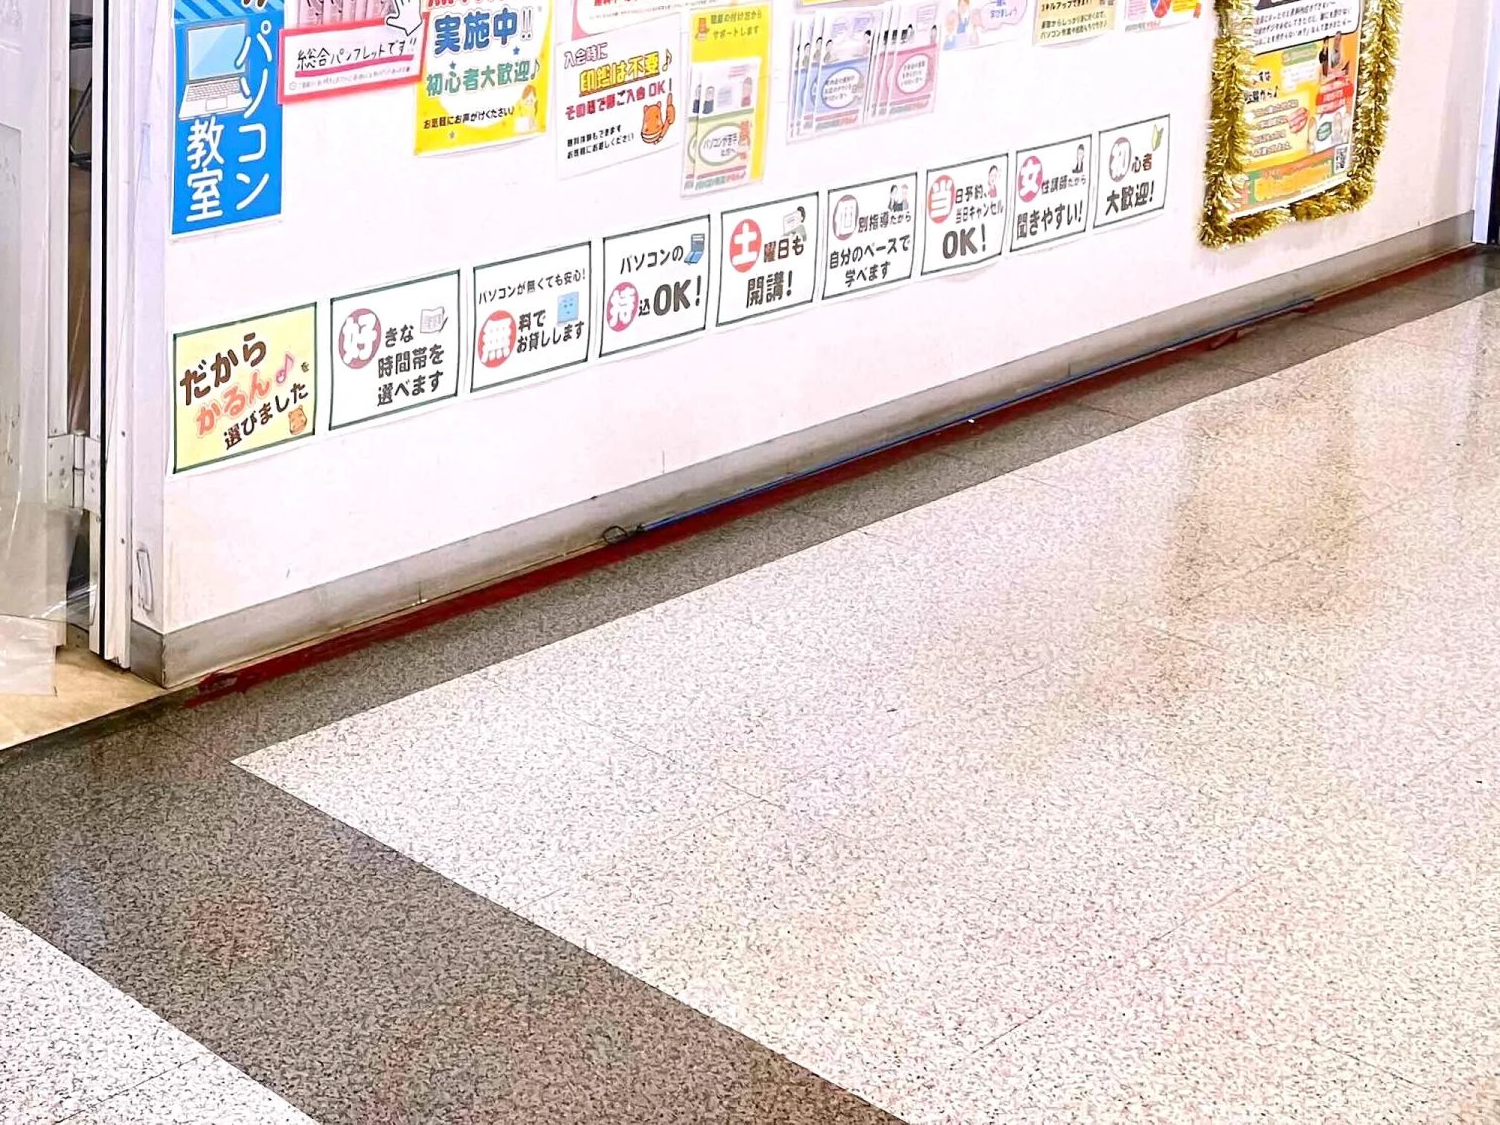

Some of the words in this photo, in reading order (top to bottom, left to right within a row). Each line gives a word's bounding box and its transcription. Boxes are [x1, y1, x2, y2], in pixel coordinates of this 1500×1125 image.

[426, 60, 532, 97] 初心者大歓迎
[235, 22, 272, 211] パソコン
[186, 116, 224, 224] 教室
[619, 247, 684, 275] パソコンの
[829, 237, 911, 269] 自分のペースで
[844, 261, 891, 288] 学べます
[180, 331, 267, 406] だから
[378, 345, 445, 379] 時間帯を
[376, 370, 443, 407] 選べます
[223, 381, 309, 451] 選びました
